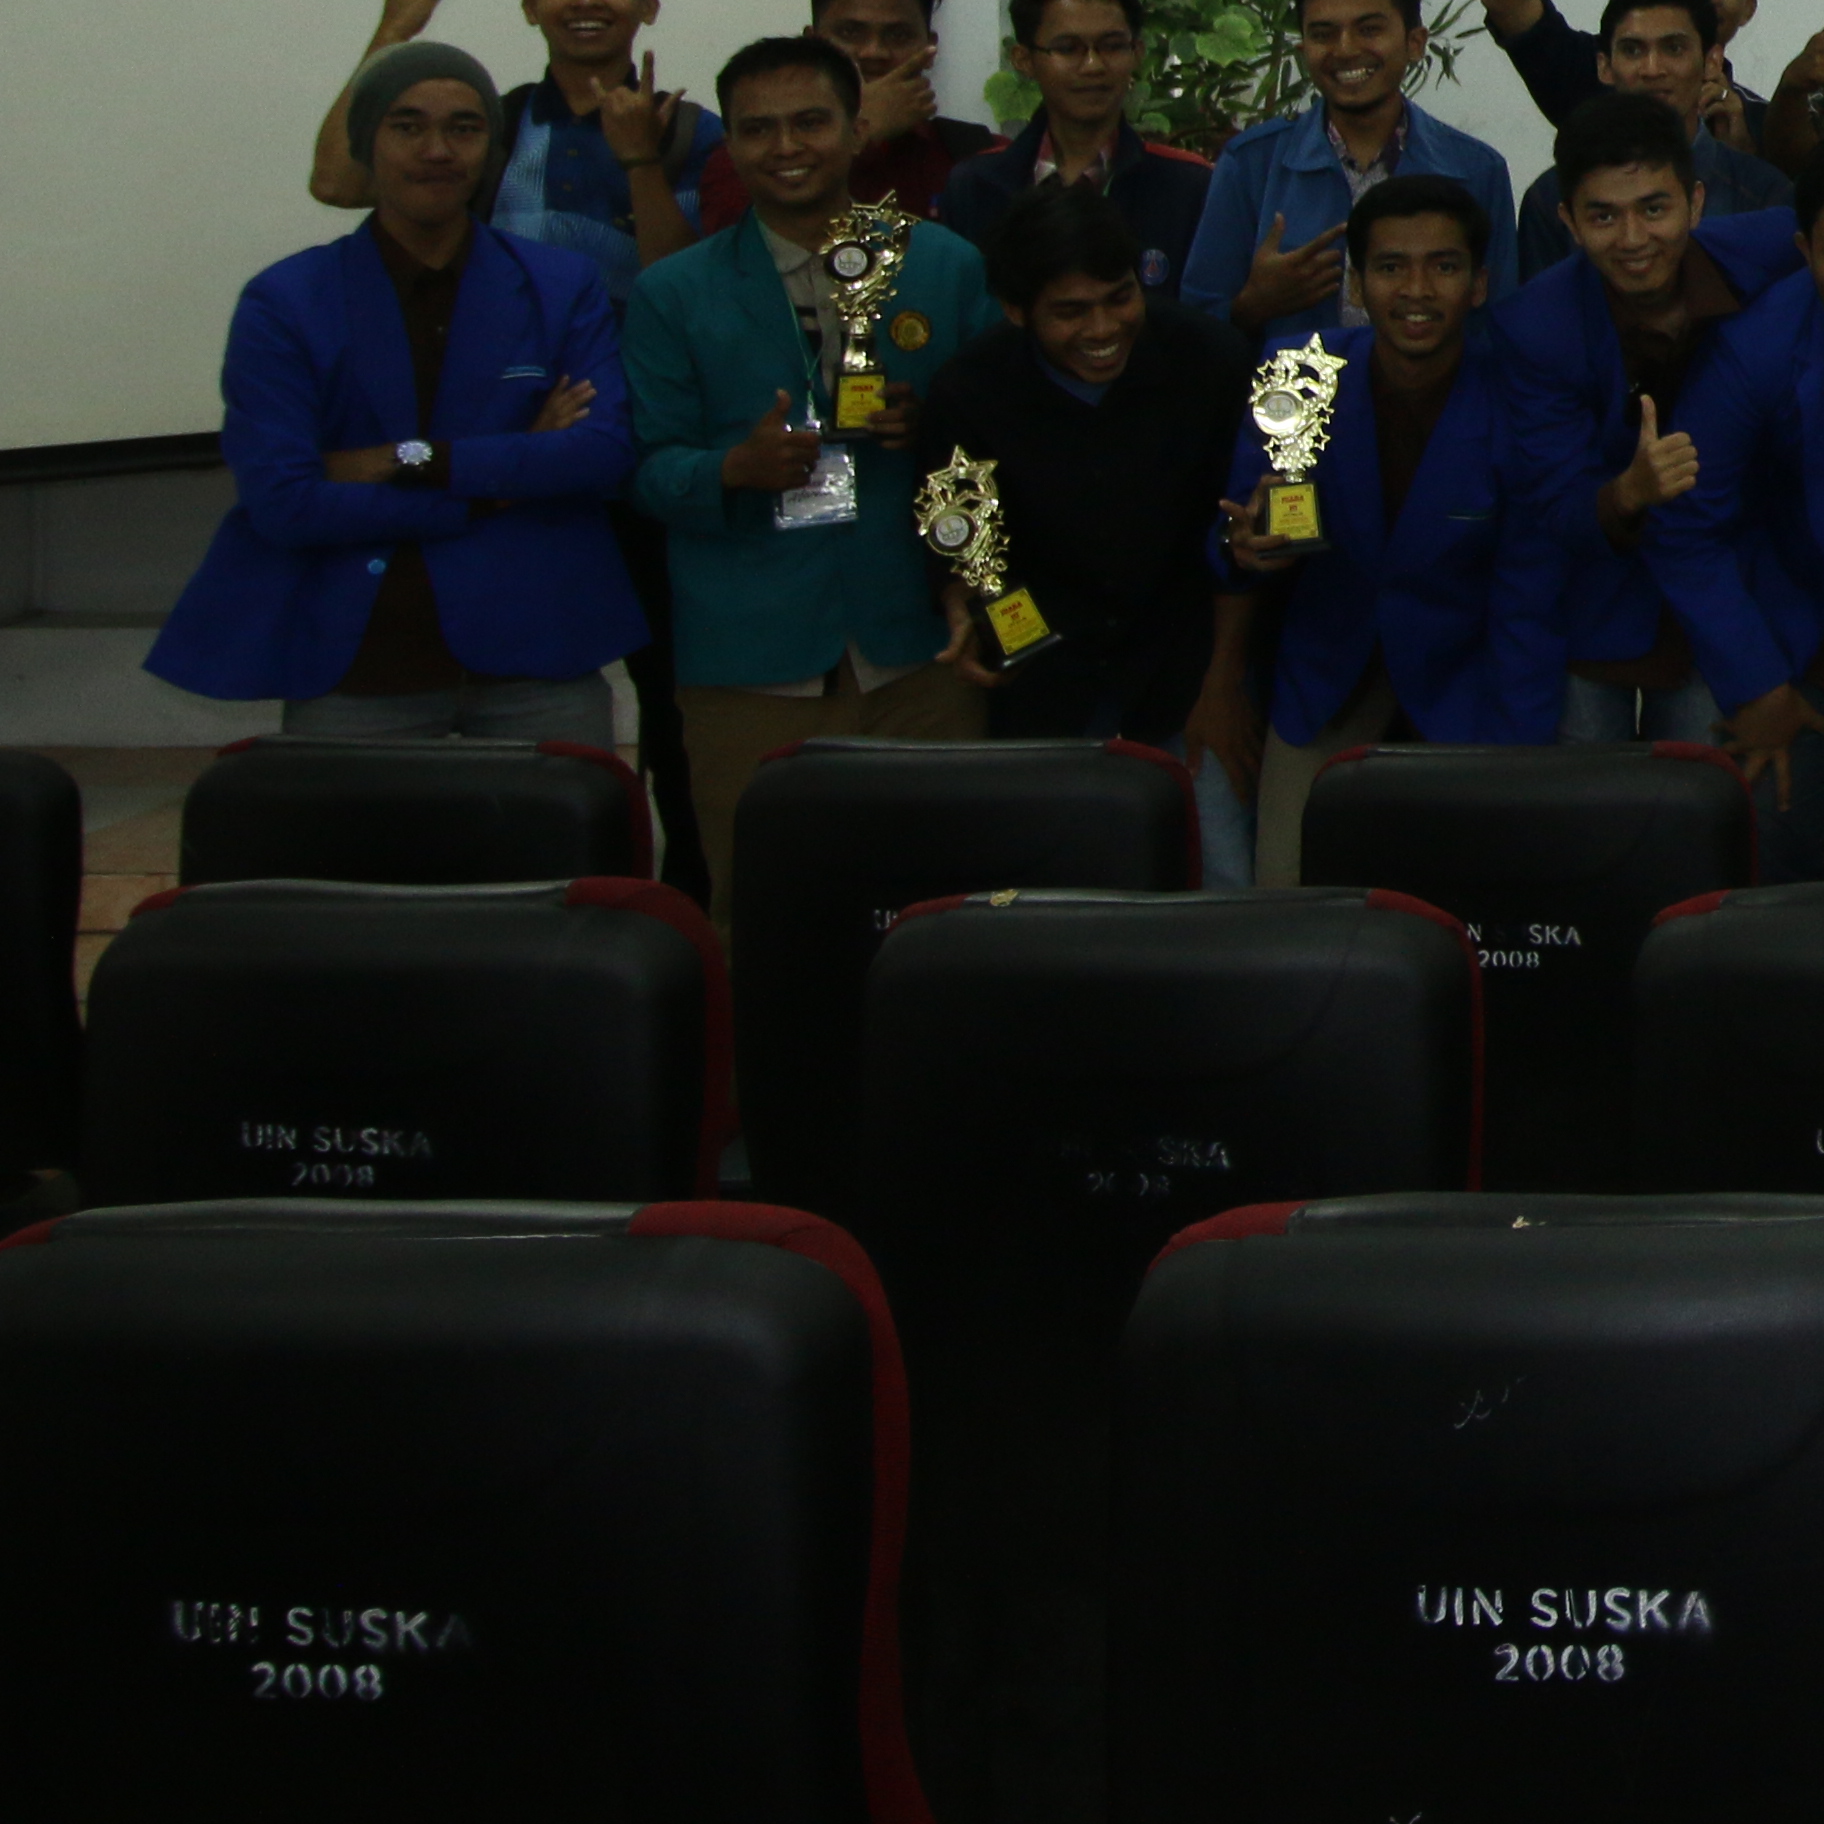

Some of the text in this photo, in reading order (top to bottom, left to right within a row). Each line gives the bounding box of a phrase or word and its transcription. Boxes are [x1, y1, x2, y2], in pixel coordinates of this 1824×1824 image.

[1476, 948, 1541, 970] 2008
[240, 1120, 434, 1160] UIN SUSKA
[290, 1161, 376, 1188] 2008
[168, 1598, 478, 1657] UIN SUSKA
[1416, 1582, 1714, 1635] UIN SUSKA
[250, 1658, 388, 1703] 2008
[1492, 1640, 1628, 1684] 2008
